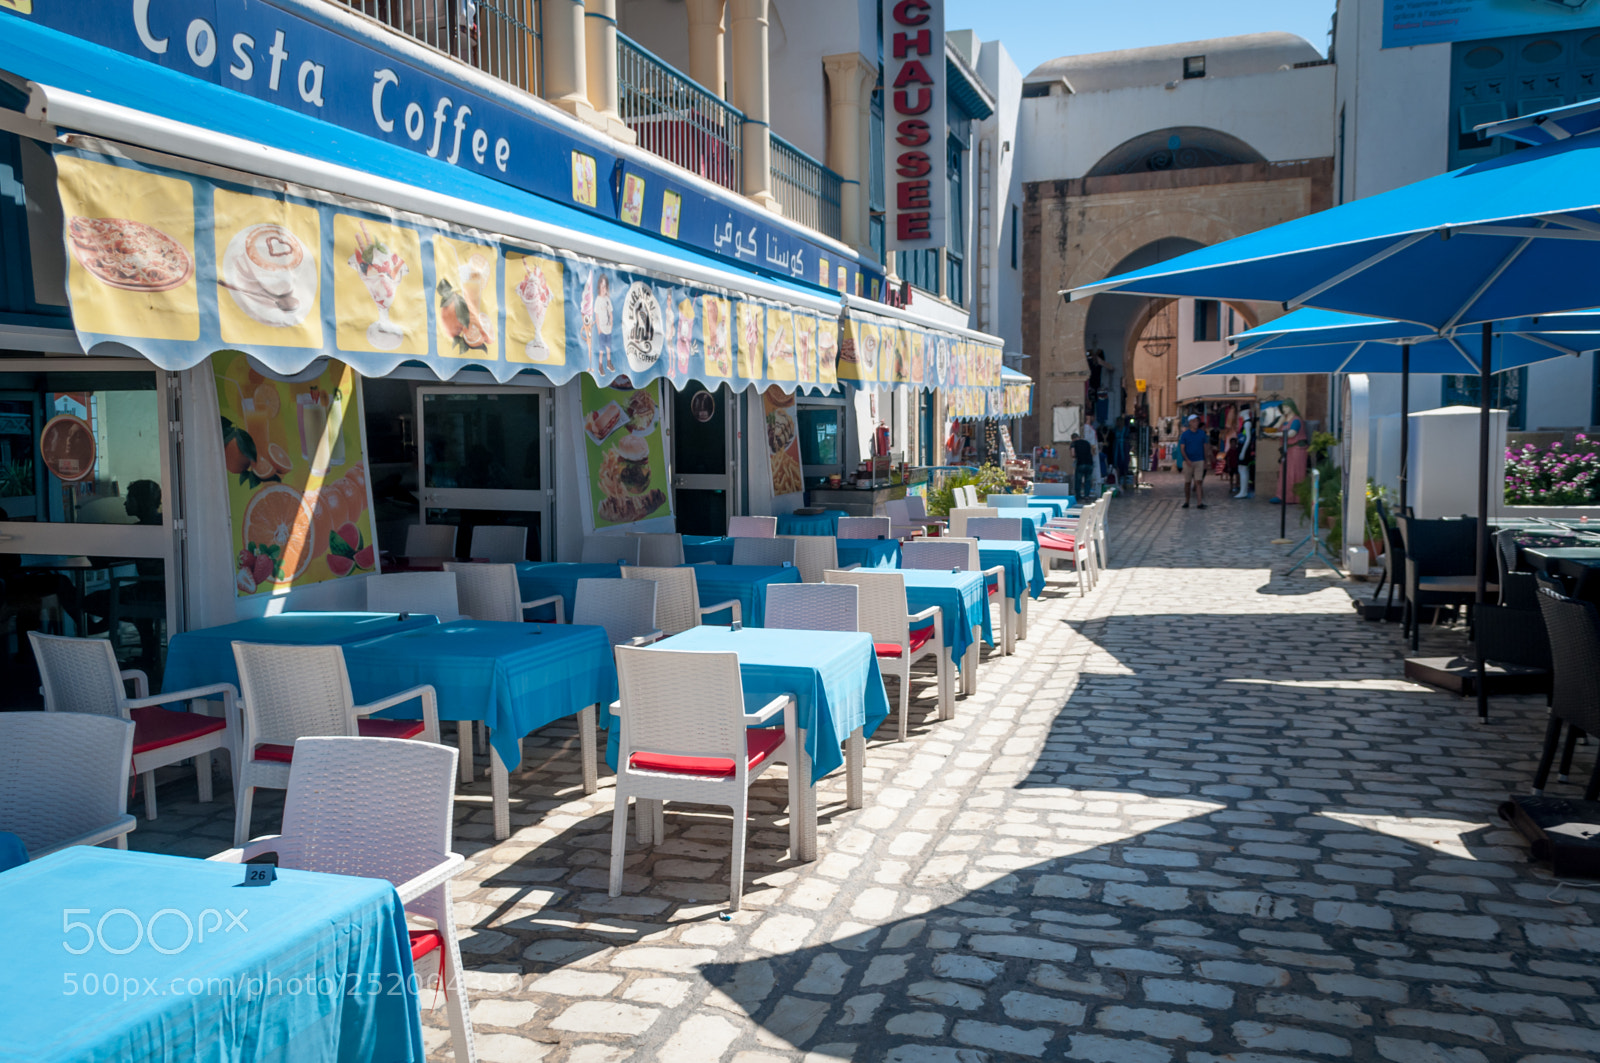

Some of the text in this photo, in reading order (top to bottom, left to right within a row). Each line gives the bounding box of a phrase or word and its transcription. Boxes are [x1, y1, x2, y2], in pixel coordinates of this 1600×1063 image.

[133, 0, 510, 172] Costa Coffee
[893, 0, 934, 241] CHAUSSEE
[714, 213, 804, 277] كوستا كوفي
[250, 870, 266, 880] 26
